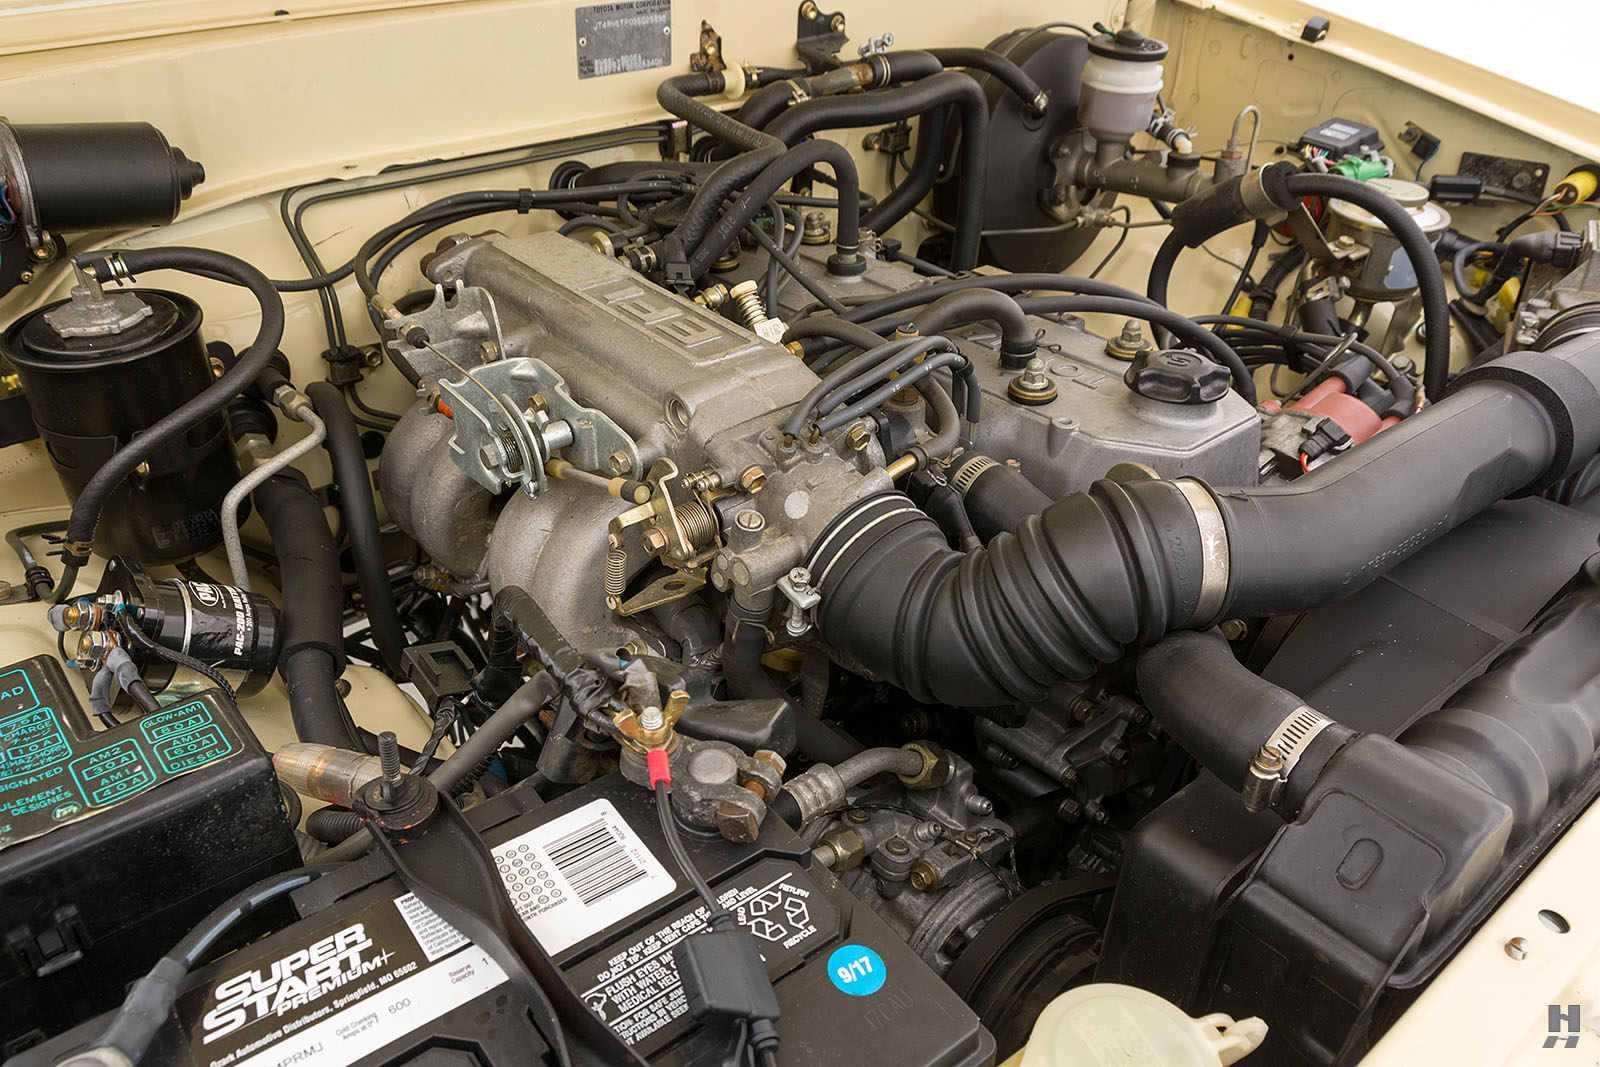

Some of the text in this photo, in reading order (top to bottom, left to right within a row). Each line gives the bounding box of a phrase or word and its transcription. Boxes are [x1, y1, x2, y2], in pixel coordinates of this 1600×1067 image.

[593, 5, 614, 14] TOYOTA
[616, 2, 634, 11] MOTOR
[233, 610, 246, 656] PAC-200
[3, 720, 53, 741] CHARGE
[172, 732, 201, 746] AM1
[88, 747, 122, 765] AM2
[170, 748, 226, 770] DIESEL
[100, 769, 131, 786] AM1
[779, 882, 810, 899] RETURN
[523, 897, 568, 922] ONTH PURCHASED
[737, 906, 747, 926] LEAD
[597, 971, 610, 982] DO
[611, 961, 628, 978] NOT
[643, 941, 662, 956] KEEP
[662, 931, 682, 945] VENT
[681, 919, 701, 934] CAPS
[721, 898, 737, 909] AND
[608, 951, 628, 967] KEEP
[628, 943, 645, 955] OUT
[645, 935, 656, 945] OF
[656, 925, 673, 939] THE
[671, 913, 694, 931] REACH
[694, 906, 706, 917] OF
[782, 924, 818, 949] RECYCLE
[215, 922, 367, 1010] SUPER
[448, 964, 472, 978] Reserve
[451, 969, 475, 985] Capacity
[605, 975, 636, 997] FLUSH
[635, 960, 660, 978] EYES
[837, 956, 873, 983] 9/17
[203, 938, 373, 1045] START
[611, 985, 636, 1004] WITH
[617, 987, 659, 1013] MEDICAL
[634, 1009, 650, 1022] FOR
[649, 997, 670, 1014] SAFE
[669, 986, 685, 1002] JUM
[236, 1028, 283, 1060] Automotive
[379, 973, 394, 987] MO
[336, 1025, 351, 1037] Cold
[350, 1012, 377, 1030] Cranking
[388, 997, 412, 1015] 600
[619, 995, 687, 1040] TRUCTIONS IN VEHIC
[635, 1015, 673, 1042] AVAILABLE
